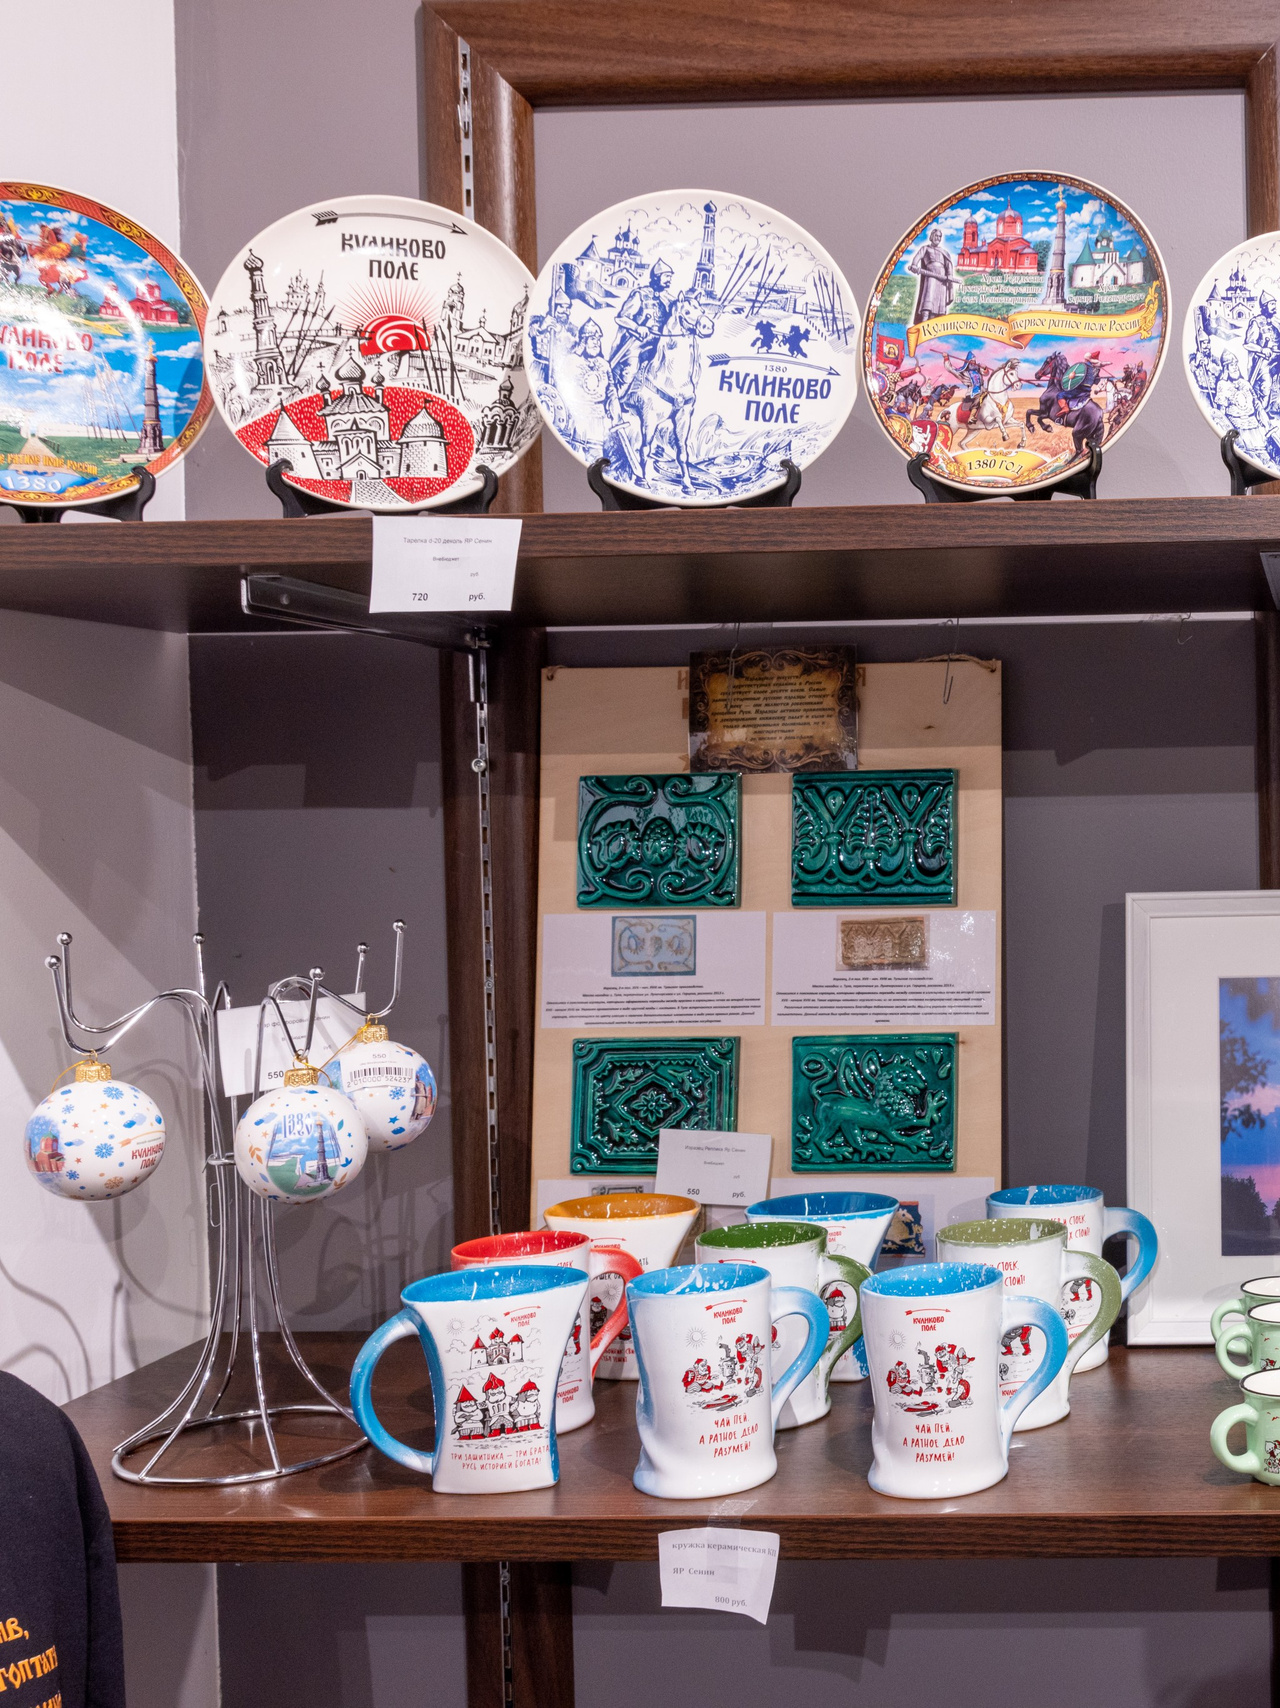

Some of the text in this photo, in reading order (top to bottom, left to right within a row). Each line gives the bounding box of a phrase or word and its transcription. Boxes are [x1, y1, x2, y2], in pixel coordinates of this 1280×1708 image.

[341, 233, 446, 260] КУЛИКОВО
[369, 259, 419, 281] ПОЛЕ
[921, 318, 1141, 338] Куликово поле первое ратное поле России
[764, 365, 787, 373] 1380
[718, 369, 832, 400] КУЛИКОВО
[745, 400, 800, 424] ПОЛЕ
[967, 459, 997, 471] 1380
[4, 475, 62, 493] 1380
[412, 592, 485, 602] 720 руб.
[267, 1070, 284, 1080] 550
[353, 1076, 382, 1086] 010000
[385, 1075, 412, 1084] 524237
[687, 1188, 746, 1199] 550 руб.
[510, 1311, 537, 1323] КУЛИКОВО
[713, 1306, 743, 1319] КУЛИКОВО
[517, 1320, 531, 1328] ПОЛЕ
[721, 1315, 737, 1325] ПОЛЕ
[912, 1316, 945, 1325] КУЛИКОВО
[921, 1324, 937, 1332] ПОЛЕ
[714, 1416, 731, 1428] ЧАЙ
[699, 1422, 759, 1445] А РАТНОЕ ДЕЛО
[915, 1423, 931, 1434] ЧАЙ
[902, 1435, 965, 1448] А РАТНОЕ ДЕЛО
[450, 1452, 463, 1461] ТРИ
[464, 1452, 504, 1462] ЗАЩИТНИКА
[515, 1449, 528, 1458] ТРИ
[529, 1444, 550, 1456] БРАТА
[713, 1440, 751, 1458] РАЗУМЕЙ!
[915, 1451, 955, 1463] РАЗУМЕЙ!
[462, 1457, 542, 1471] РУСЬ ИСТОРИЕЙ БОГАТА!
[672, 1542, 705, 1550] кружка
[707, 1543, 766, 1554] керамическая
[672, 1567, 715, 1576] ЯР Сенин
[715, 1596, 748, 1608] 800 руб.
